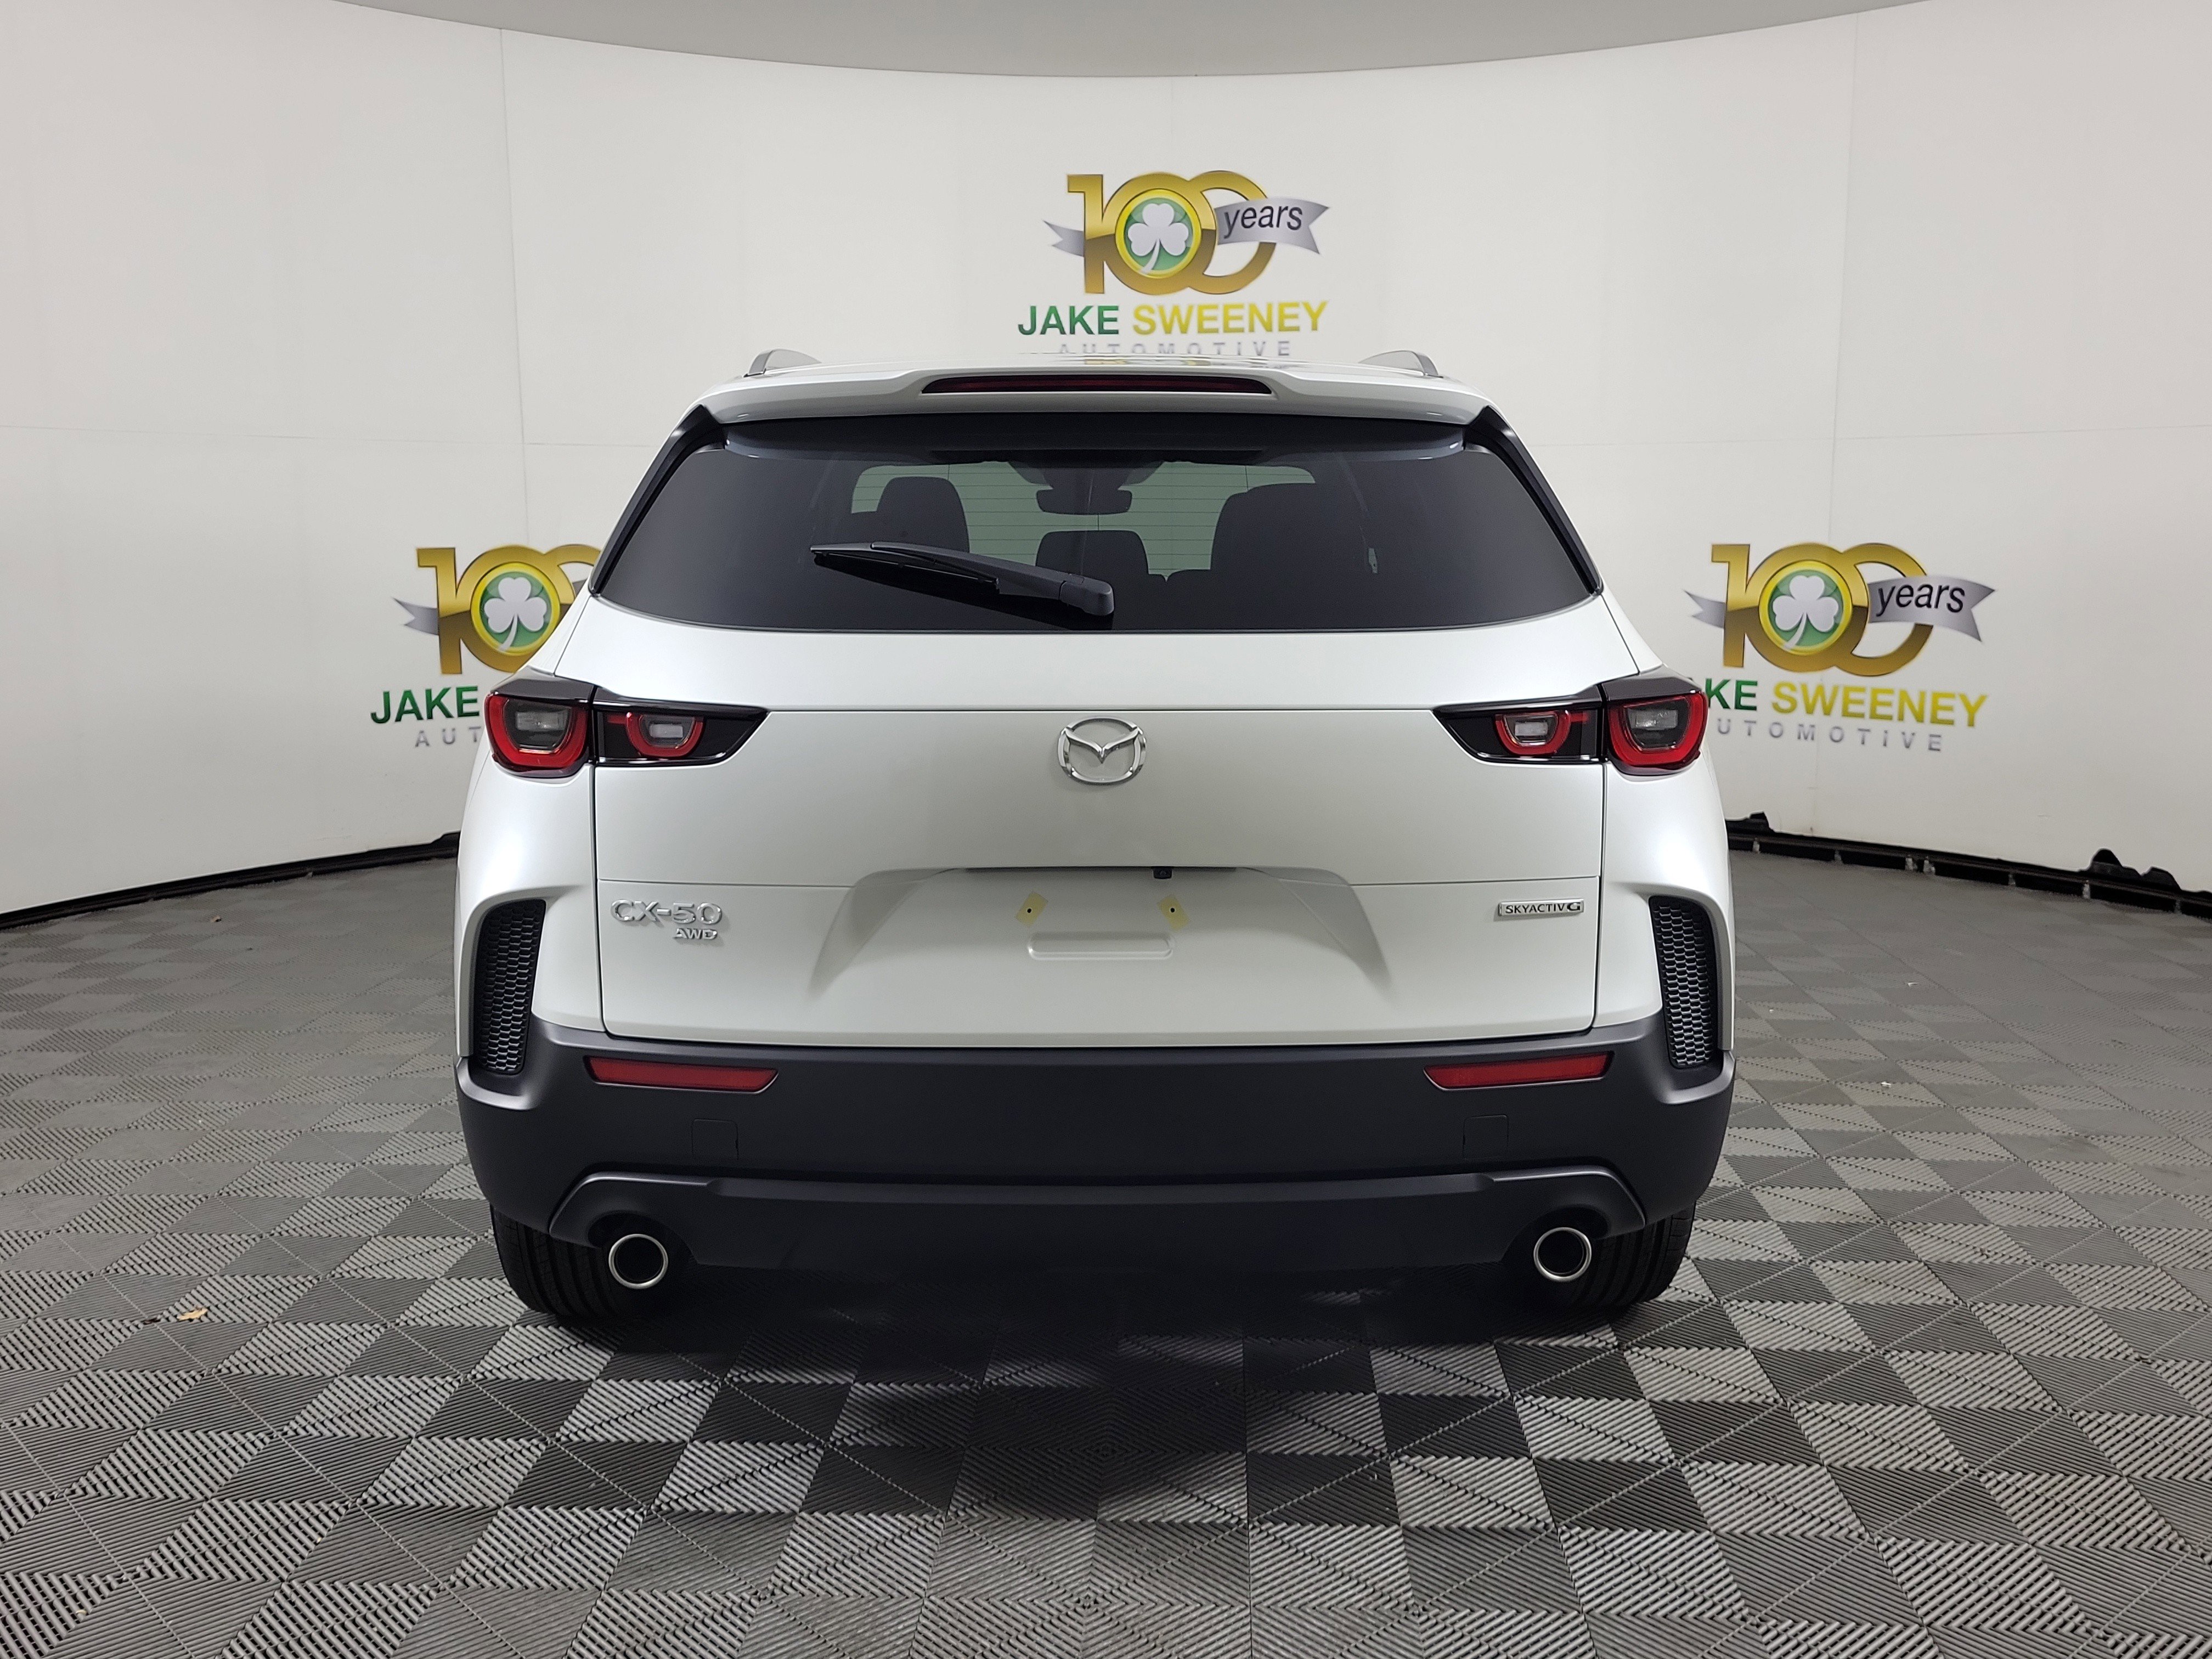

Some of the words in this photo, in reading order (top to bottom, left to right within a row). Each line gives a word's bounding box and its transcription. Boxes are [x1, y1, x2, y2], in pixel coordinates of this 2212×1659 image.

[1067, 171, 1277, 295] 100
[1223, 205, 1304, 240] years
[1018, 306, 1120, 336] JAKE
[1132, 301, 1329, 336] SWEENEY
[1059, 341, 1290, 356] AUTOMOTIVE
[1711, 542, 1935, 677] 100
[1875, 584, 1966, 617] years
[370, 686, 480, 724] JAKE
[1705, 678, 1758, 711] KE
[1771, 681, 1988, 727] SWEENEY
[415, 726, 481, 747] AUT
[1717, 718, 1943, 752] UTOMOTIVE
[611, 899, 723, 924] CX-50
[673, 928, 718, 940] AWD
